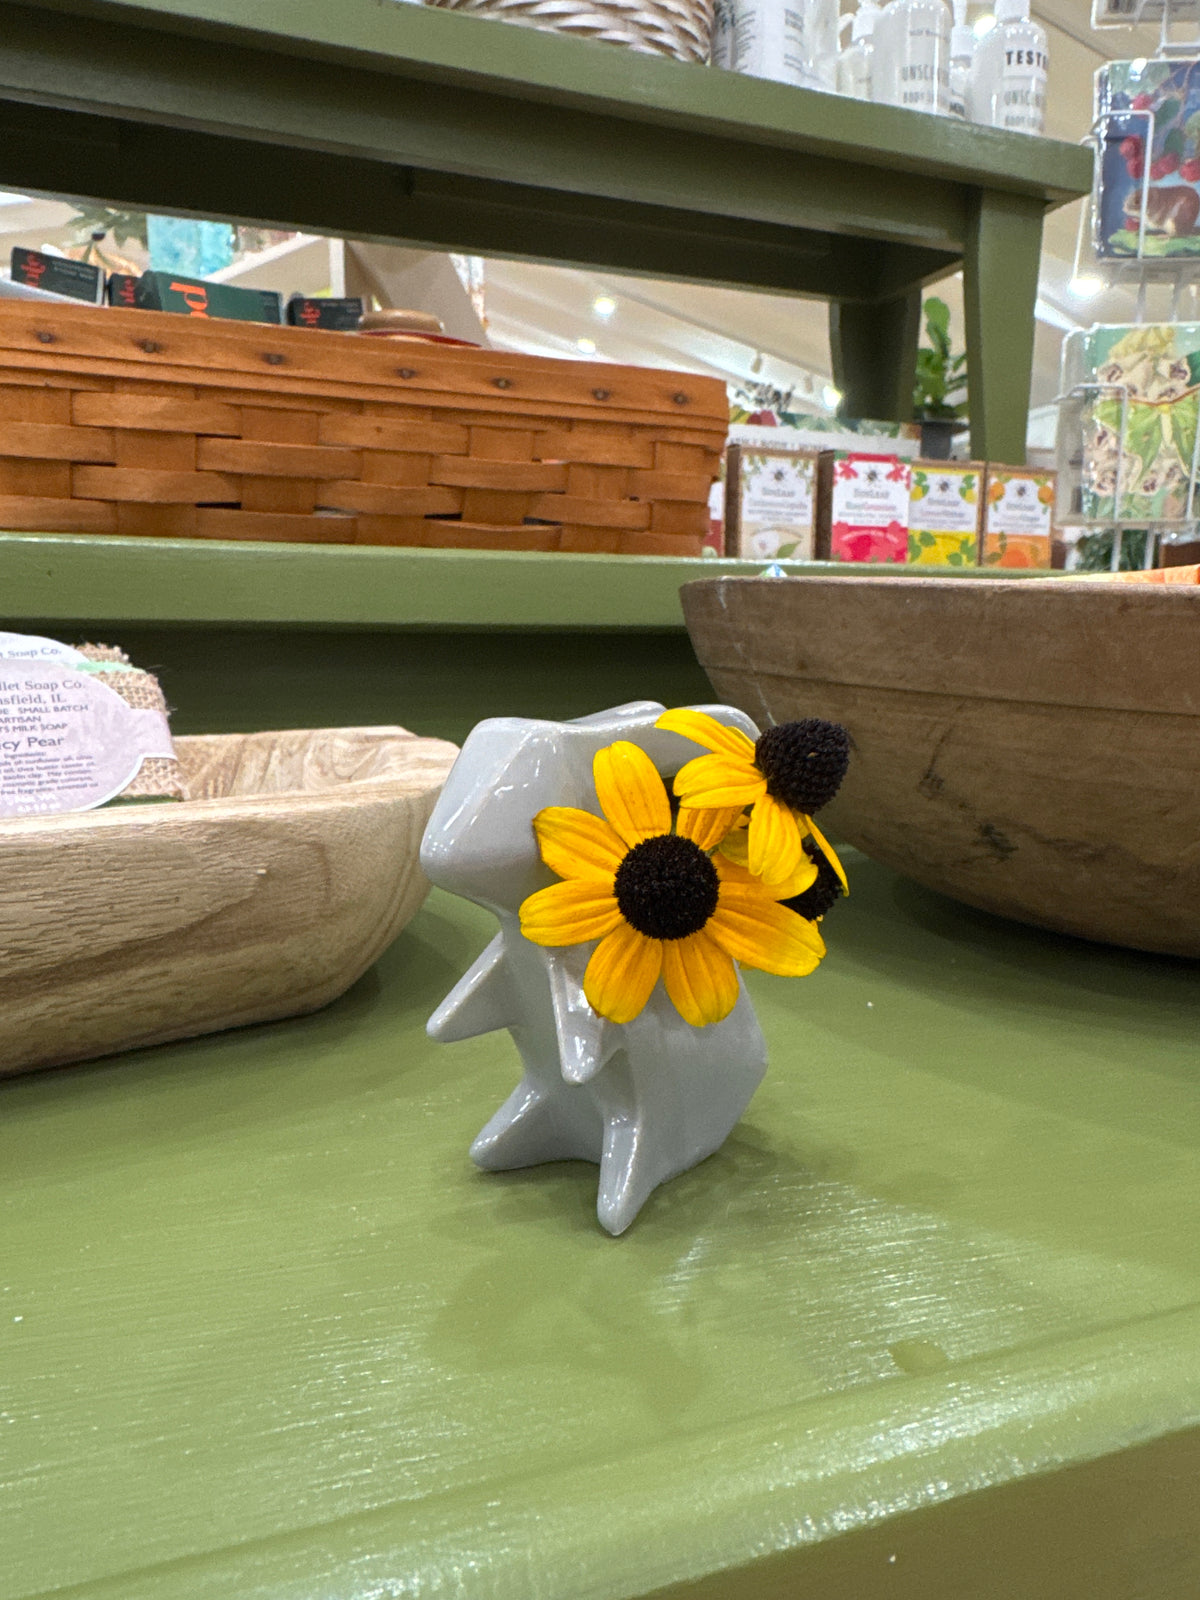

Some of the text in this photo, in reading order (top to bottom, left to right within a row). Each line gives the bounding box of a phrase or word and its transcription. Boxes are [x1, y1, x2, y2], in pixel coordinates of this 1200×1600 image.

[24, 680, 58, 692] Soap
[62, 679, 86, 690] Co.
[18, 706, 51, 714] SMALL
[53, 704, 89, 713] BATCH
[13, 724, 37, 732] MILK
[40, 722, 68, 731] SOAP
[27, 736, 64, 747] Pear
